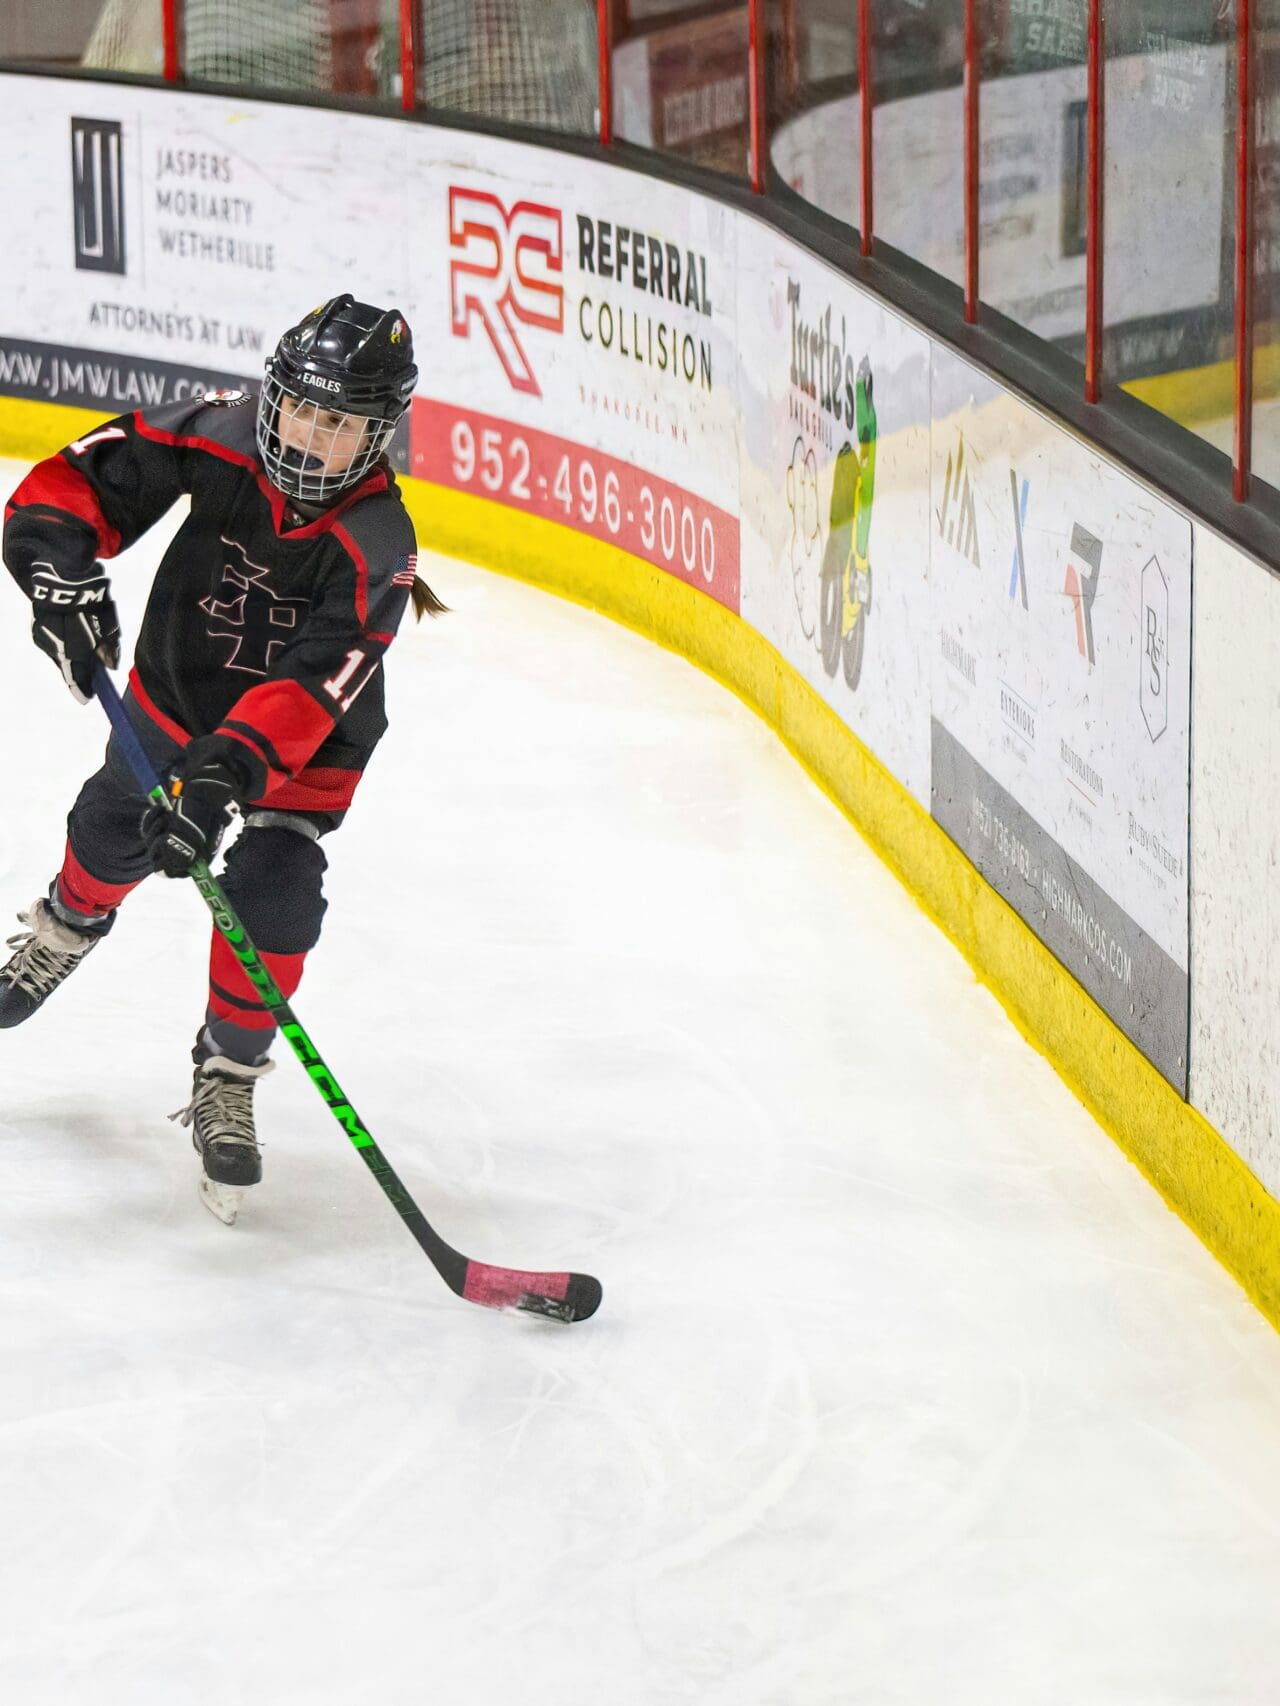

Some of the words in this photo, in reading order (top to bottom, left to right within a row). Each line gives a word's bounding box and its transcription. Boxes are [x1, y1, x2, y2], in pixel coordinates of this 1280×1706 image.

[154, 148, 232, 184] JASPERS
[156, 188, 253, 226] MORIARTY
[576, 213, 712, 317] REFERRAL
[89, 302, 194, 341] ATTORNEYS
[579, 296, 712, 392] COLLISION
[787, 276, 855, 431] Turtle's
[303, 372, 341, 393] EAGLES
[451, 419, 716, 584] 952-496-3000
[33, 584, 106, 606] CCM
[282, 1023, 375, 1150] CCM
